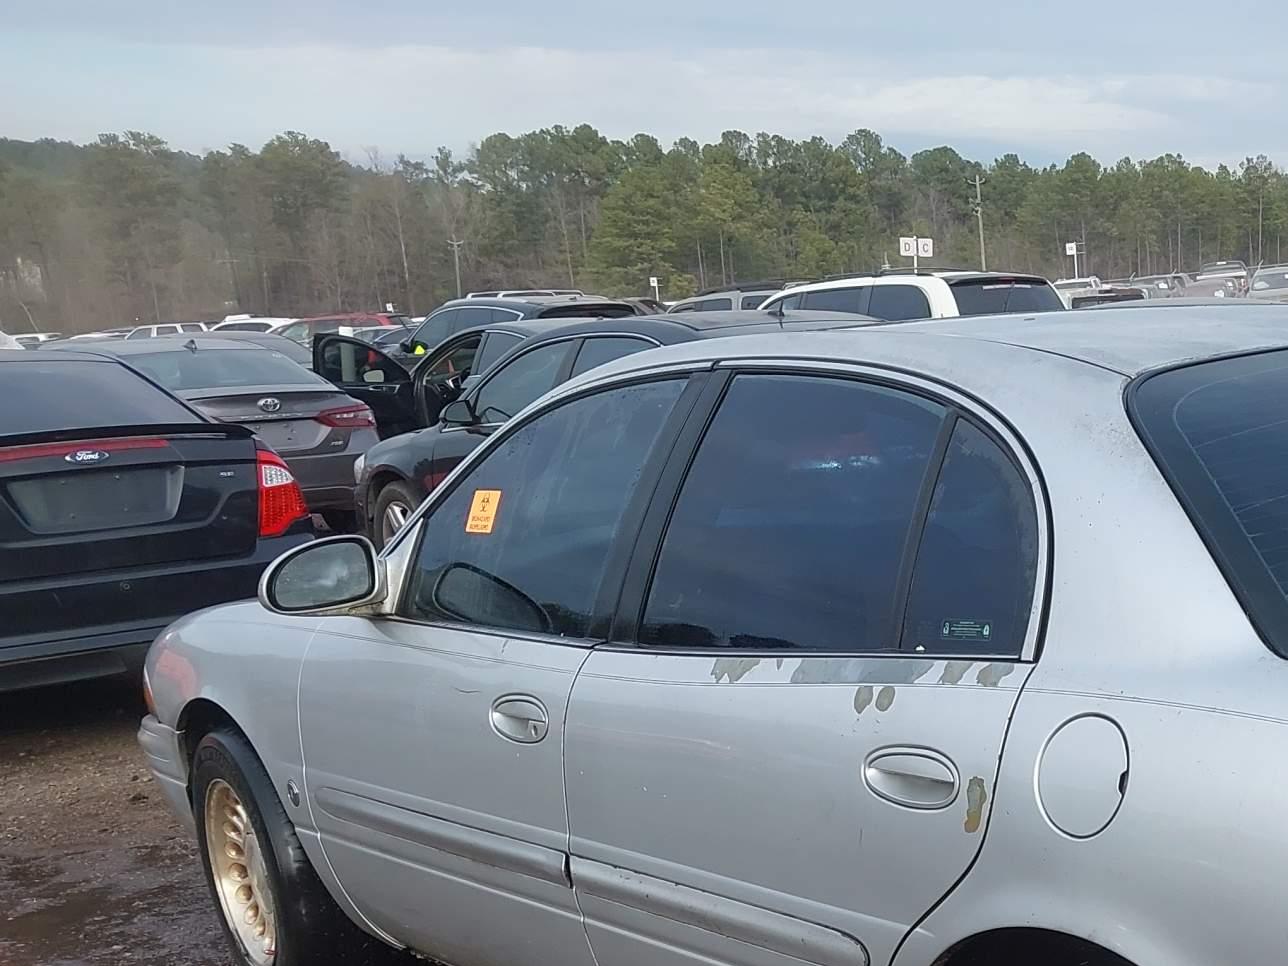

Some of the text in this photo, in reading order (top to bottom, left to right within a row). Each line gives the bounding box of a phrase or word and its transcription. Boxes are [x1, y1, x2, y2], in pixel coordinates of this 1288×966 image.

[904, 242, 911, 252] D
[922, 243, 929, 253] C
[75, 450, 100, 461] Ford
